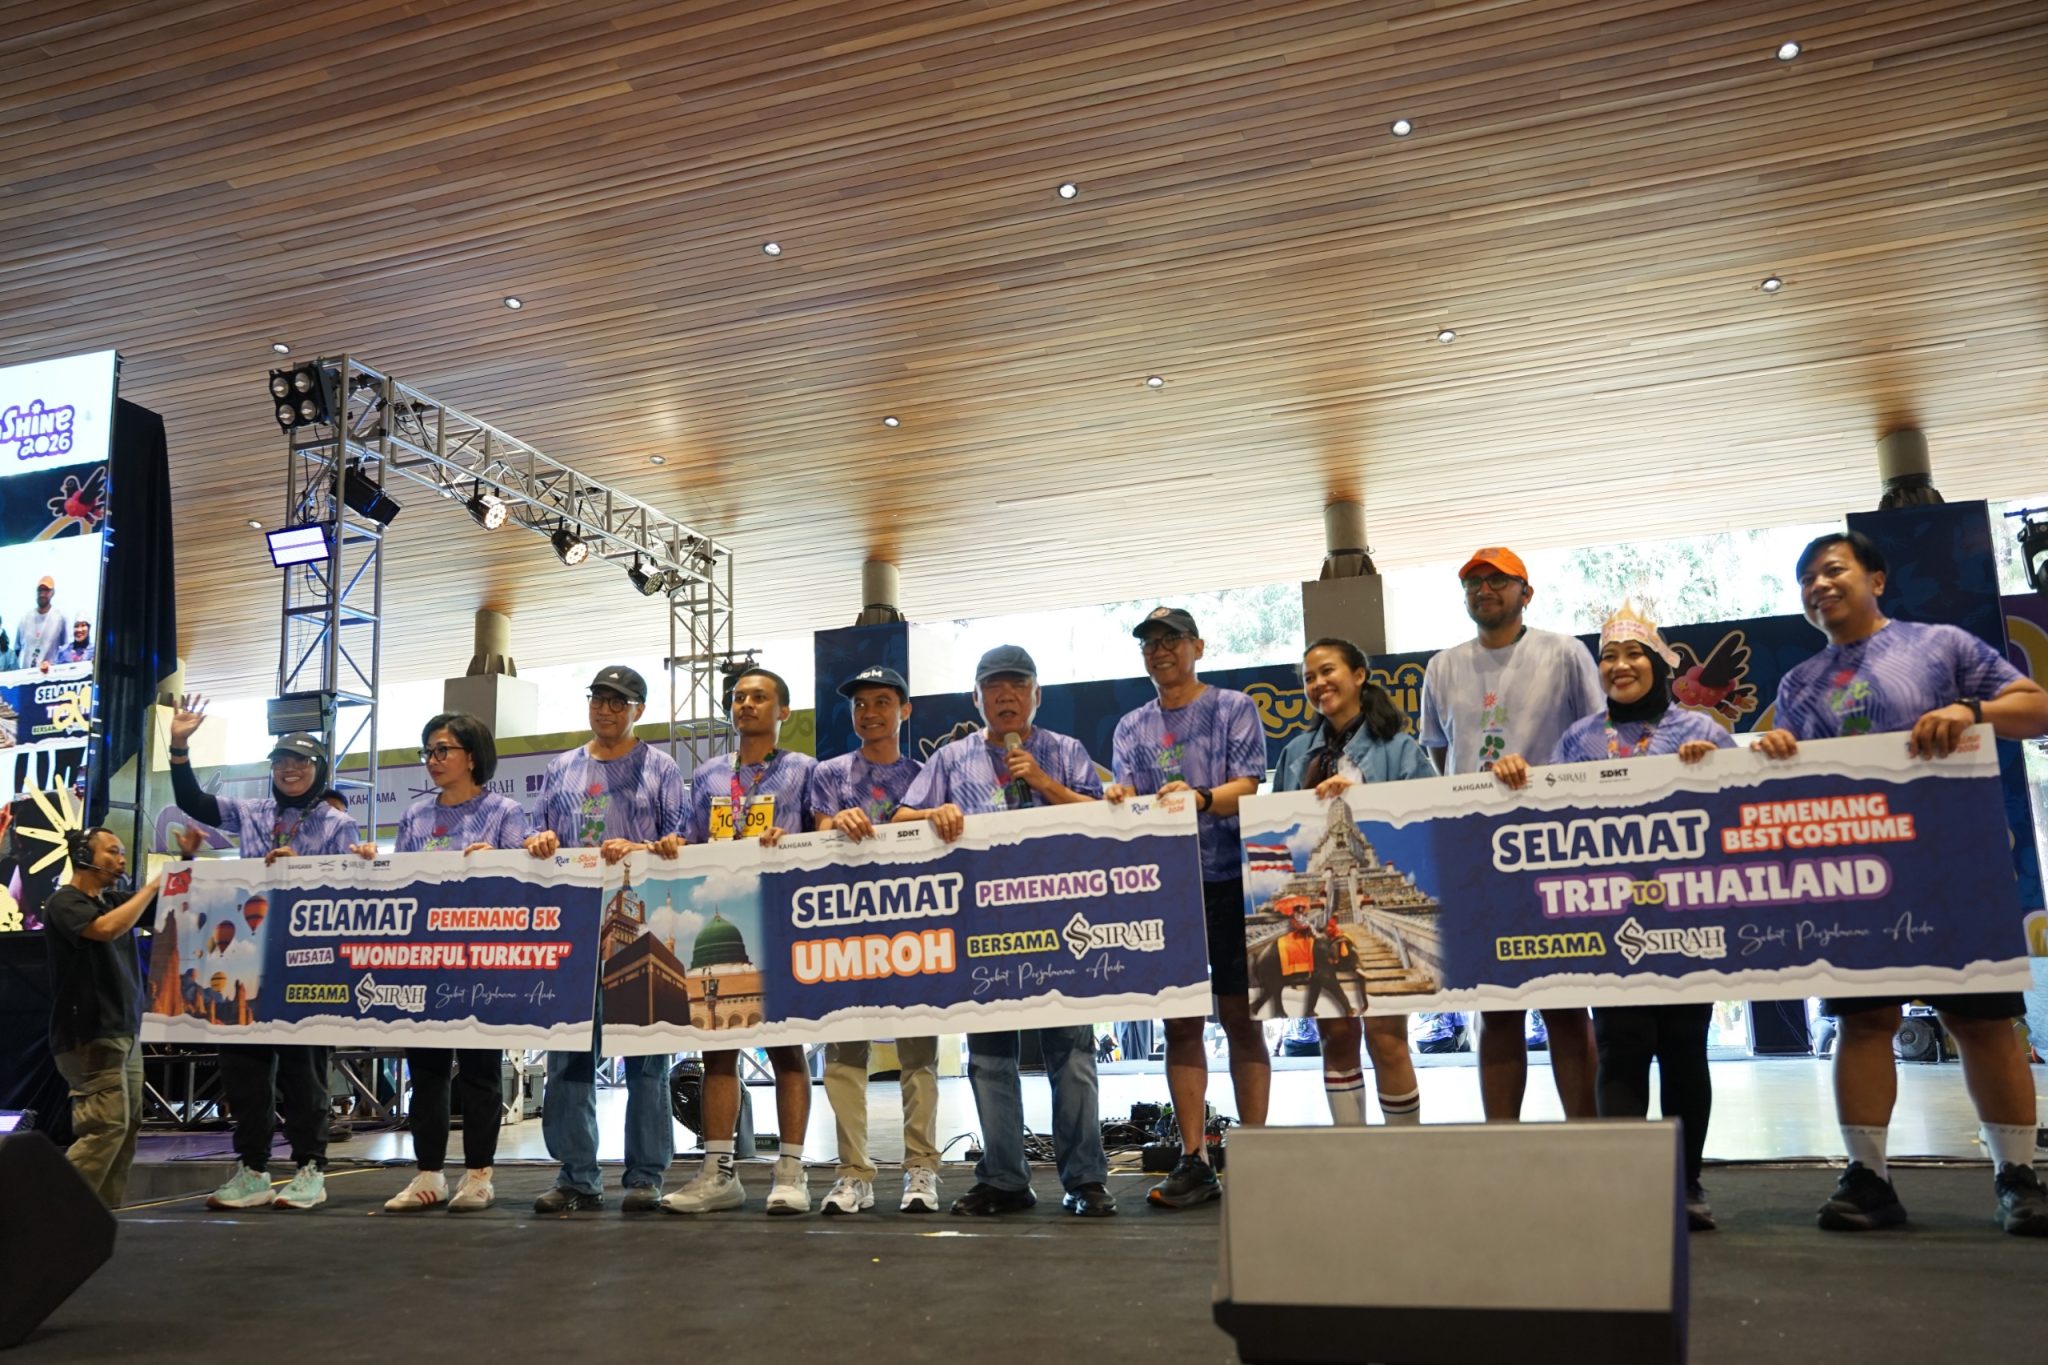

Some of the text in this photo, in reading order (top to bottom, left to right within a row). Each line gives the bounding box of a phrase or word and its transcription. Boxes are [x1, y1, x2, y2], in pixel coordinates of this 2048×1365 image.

[1600, 768, 1629, 779] SDKT
[349, 791, 397, 806] KAHAMA
[1452, 781, 1494, 793] KAHGAMA
[1743, 796, 1886, 826] PEMENANG
[1499, 816, 1702, 866] SELAMAT
[1723, 817, 1912, 851] BEST COSTUME
[979, 868, 1157, 903] PEMENANG 10K
[1539, 859, 1888, 914] TRIP TO THAILAND
[797, 878, 958, 923] SELAMAT
[293, 903, 414, 932] SELAMAT
[429, 909, 560, 928] PEMENANG 5K
[795, 931, 953, 980] UMROH
[970, 932, 1057, 954] BERSAMA
[1499, 936, 1602, 958] BERSAMA
[287, 949, 333, 965] WISATA
[287, 986, 348, 1001] BERSAMA
